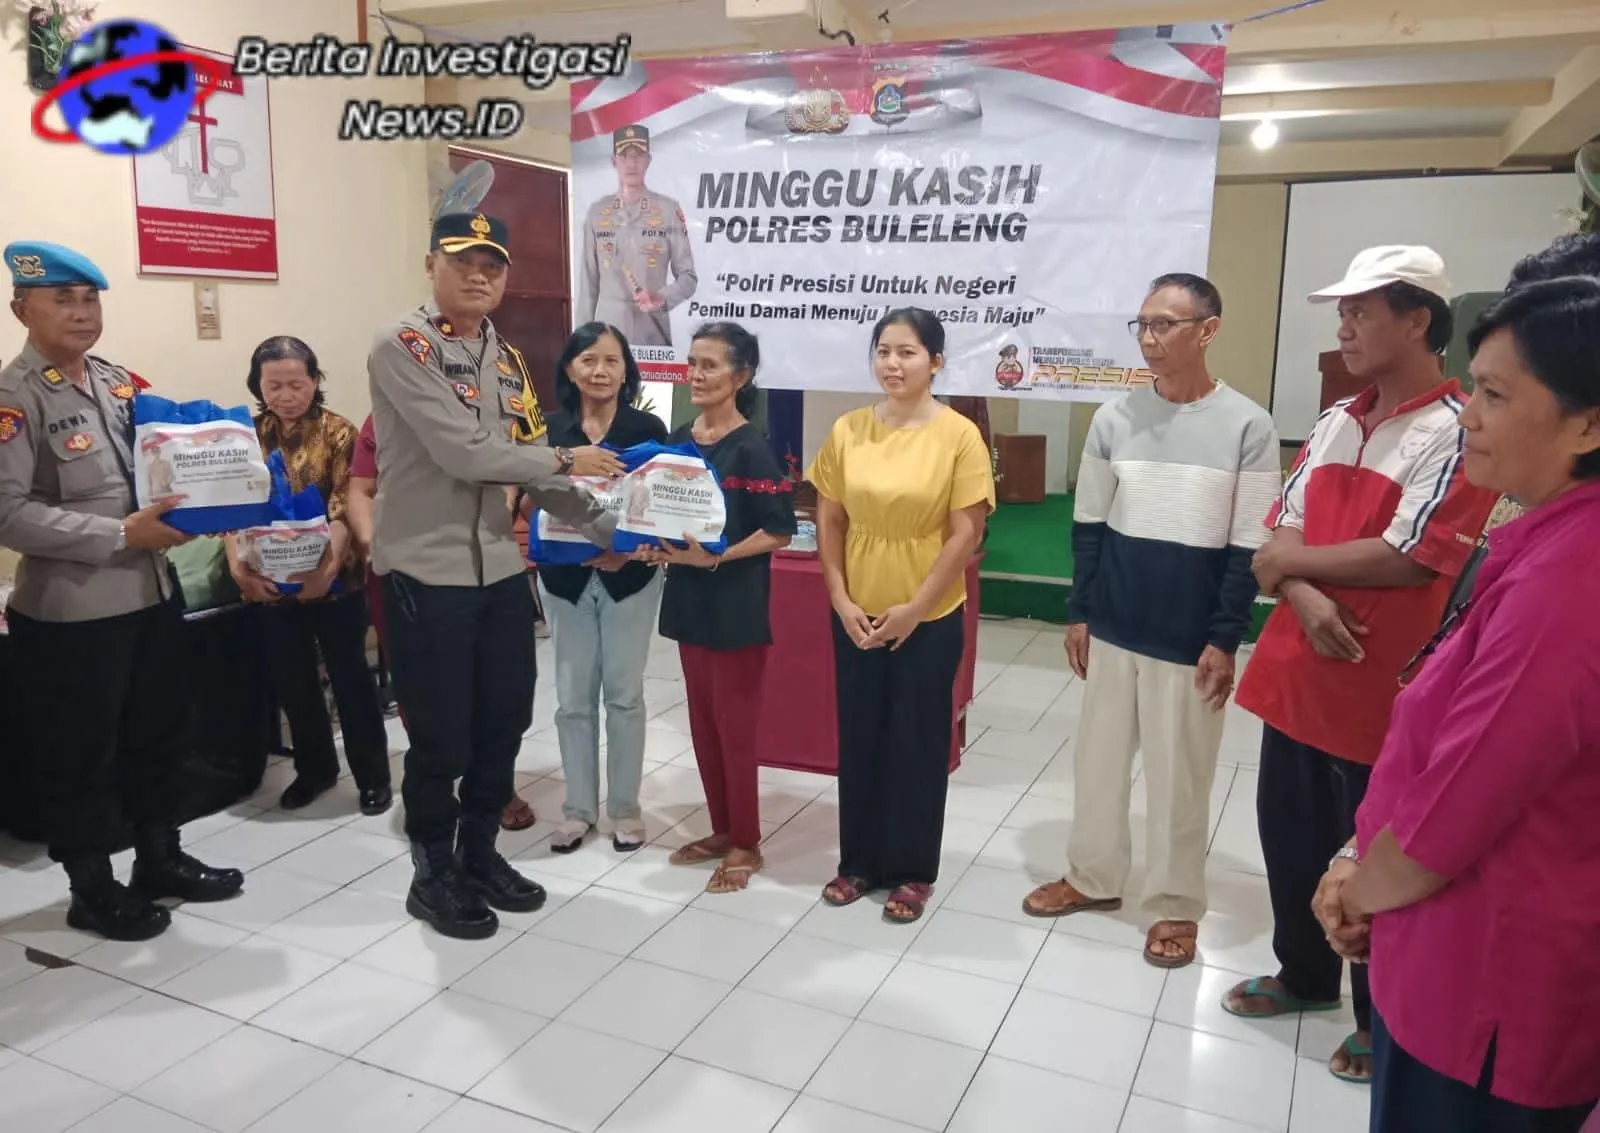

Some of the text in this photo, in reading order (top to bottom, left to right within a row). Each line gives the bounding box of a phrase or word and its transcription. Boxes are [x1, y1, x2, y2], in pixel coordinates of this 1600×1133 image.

[696, 163, 1042, 209] MINGGU KASIH
[705, 211, 1029, 244] POLRES BULELENG
[716, 273, 1016, 299] “Polri Presisi Untuk Negeri
[687, 302, 746, 319] Pemilu
[749, 302, 806, 320] Damai
[810, 303, 879, 325] Menuju
[984, 306, 1046, 327] Maju”
[637, 348, 675, 361] BULELENG
[48, 414, 89, 435] DEWA
[173, 448, 249, 461] MINGGU KASIH
[652, 483, 713, 498] MINGGU KASIH
